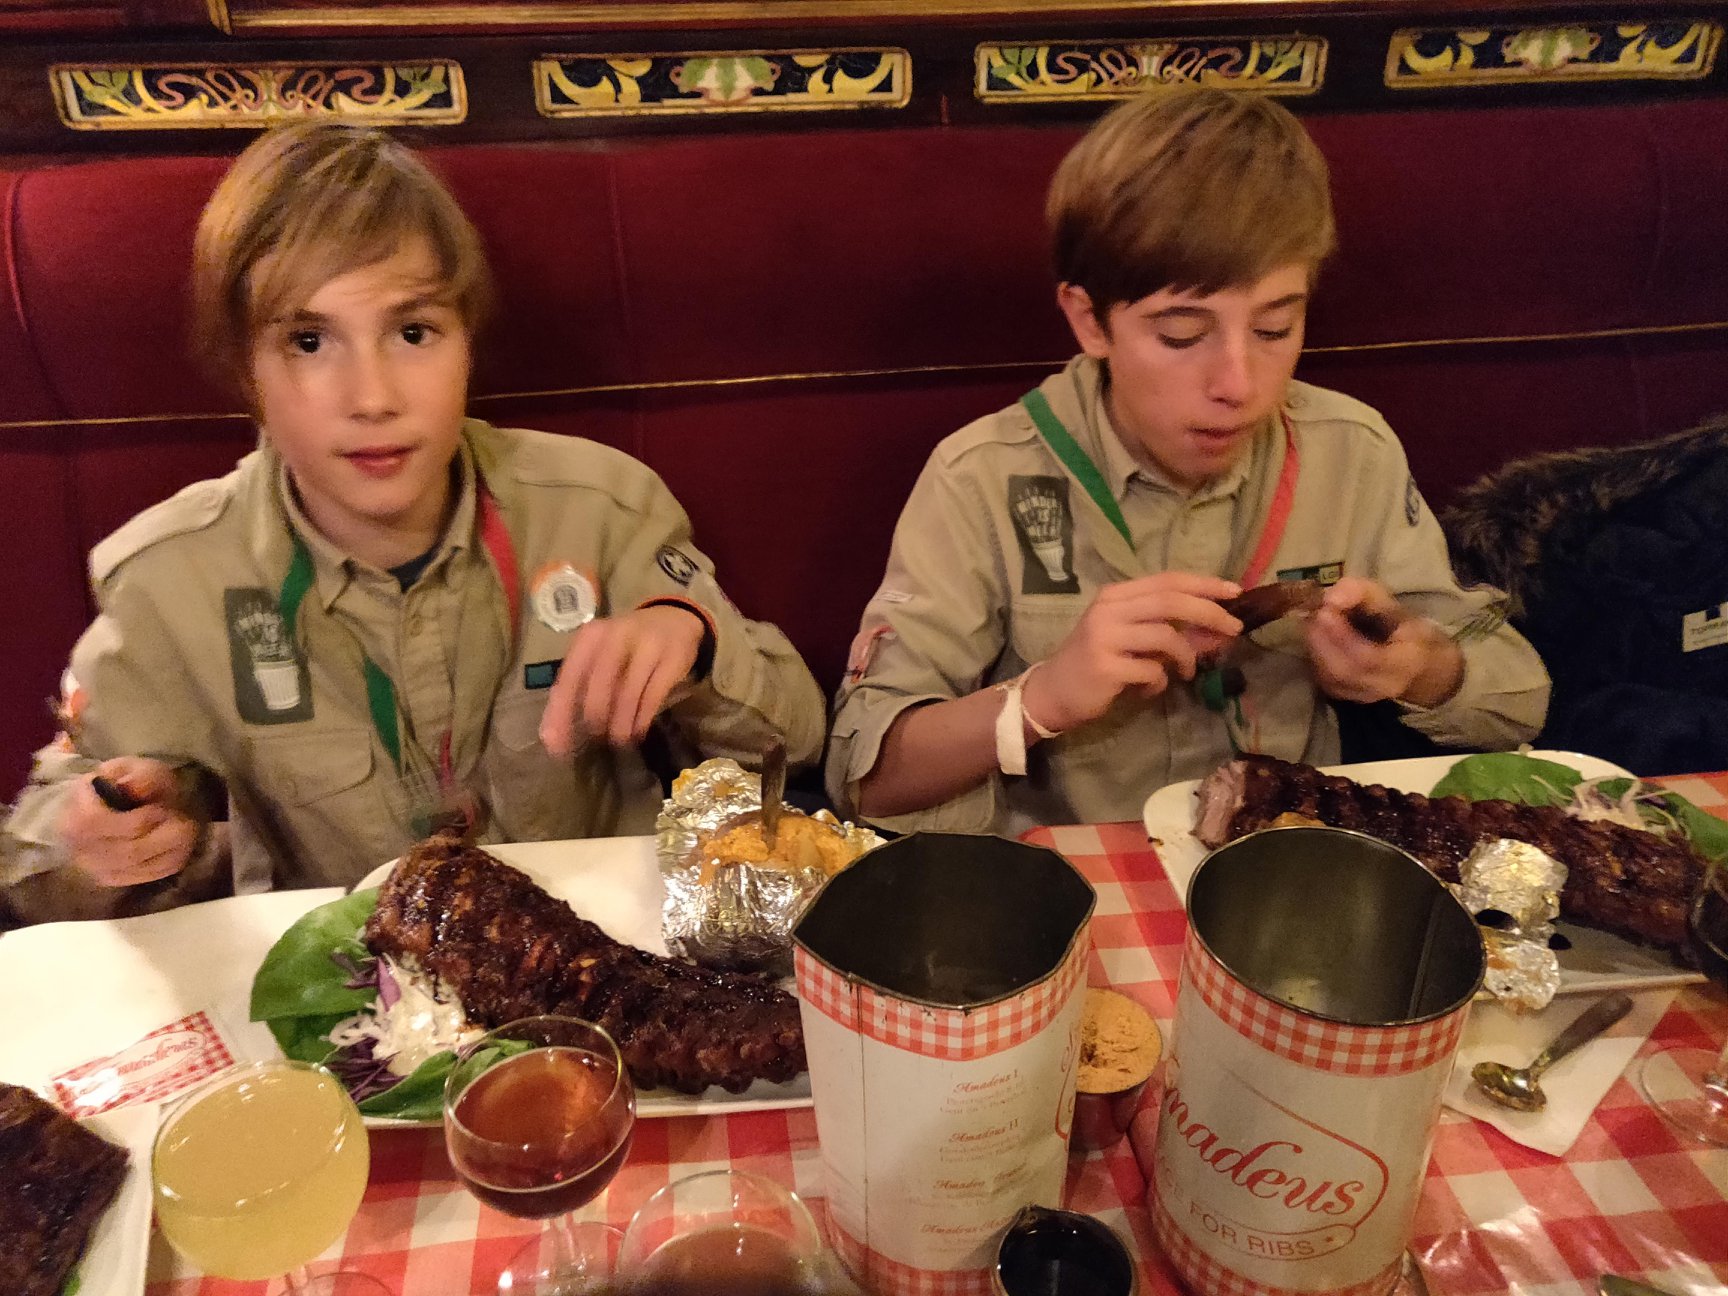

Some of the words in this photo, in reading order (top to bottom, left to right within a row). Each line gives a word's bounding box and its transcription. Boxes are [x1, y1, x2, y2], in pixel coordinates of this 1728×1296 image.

[952, 1073, 1011, 1093] Amadeus
[949, 1127, 1006, 1143] Amadeus
[1164, 1087, 1364, 1215] madeus
[1189, 1200, 1237, 1244] FOR
[1248, 1234, 1315, 1256] RIBS
